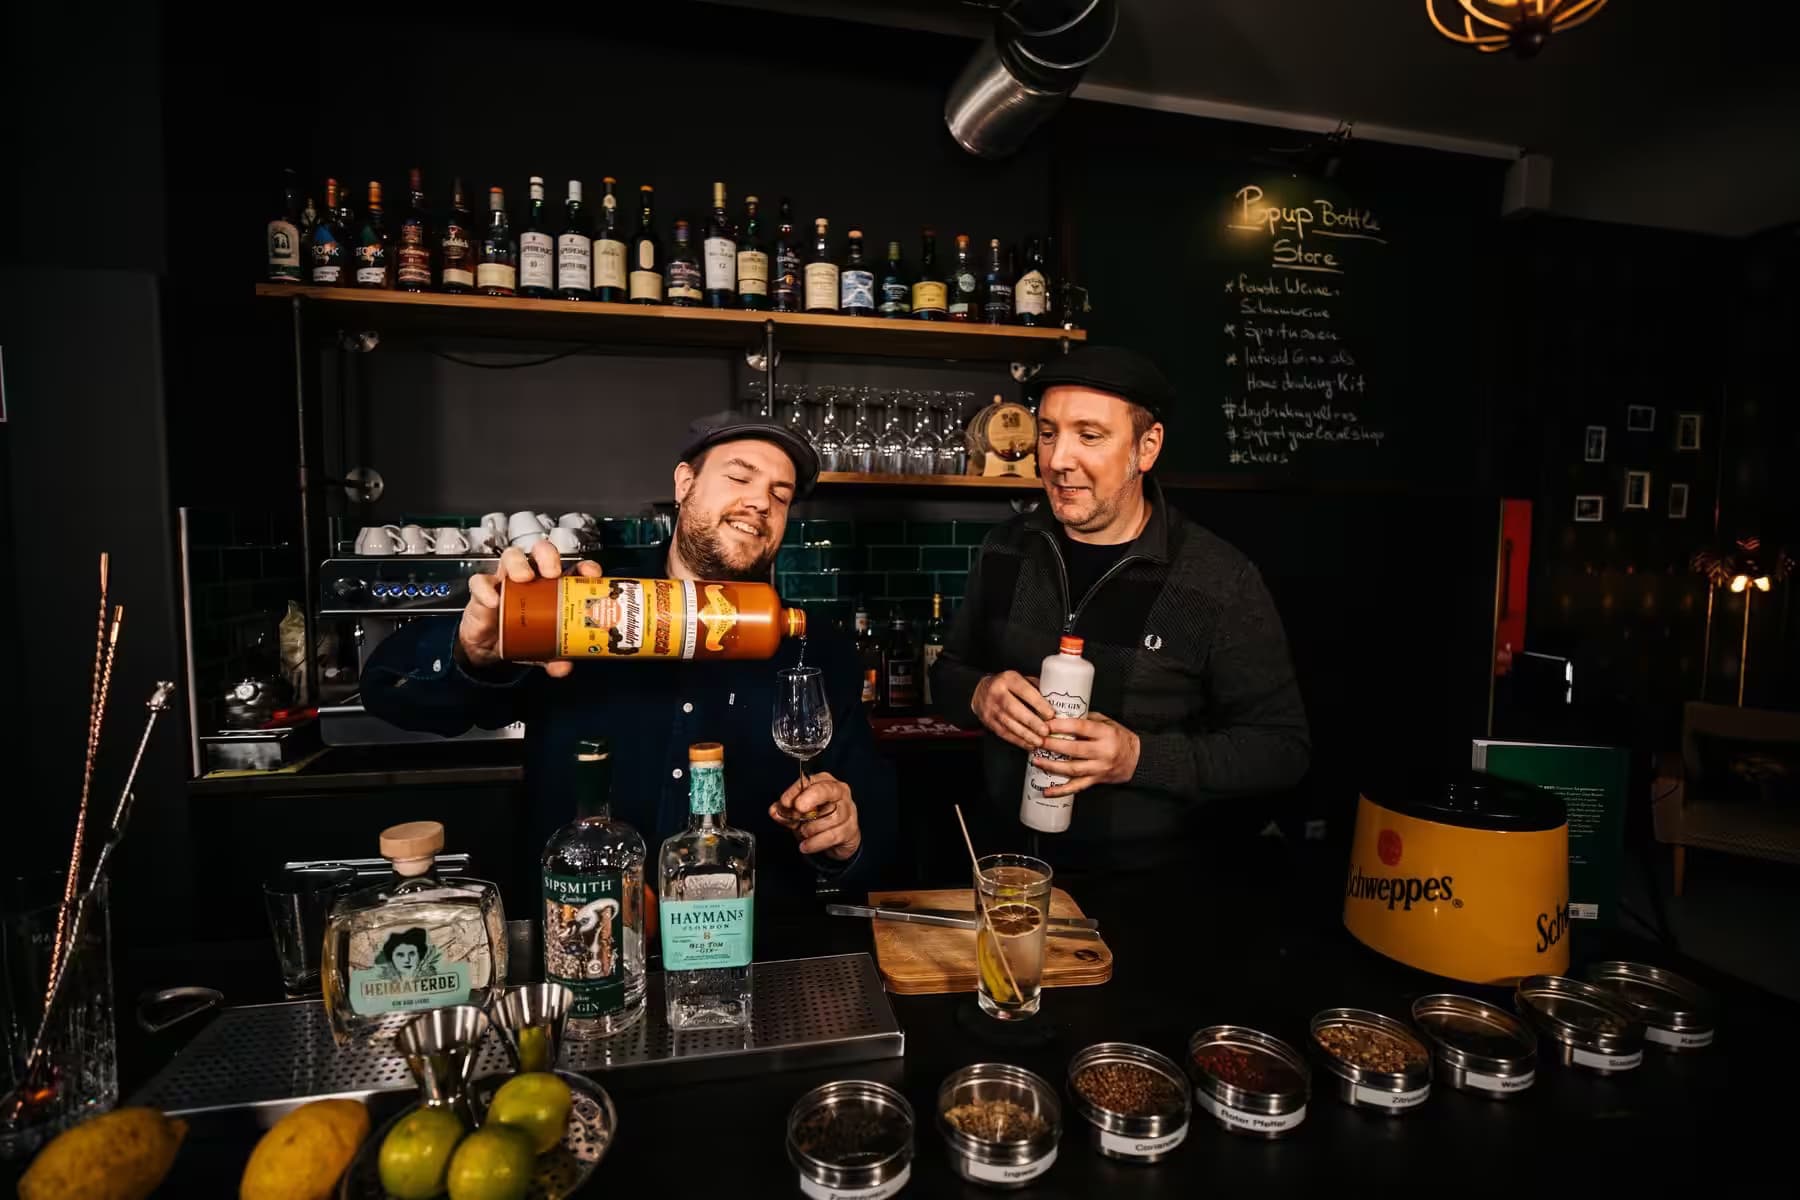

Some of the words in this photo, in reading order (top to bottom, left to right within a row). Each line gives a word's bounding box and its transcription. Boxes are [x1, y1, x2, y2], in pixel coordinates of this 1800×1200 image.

[1235, 185, 1314, 240] Popup
[1313, 199, 1381, 231] Bottle
[1272, 238, 1339, 266] Store
[1337, 371, 1366, 393] Kit
[1069, 702, 1082, 711] GIN
[544, 876, 612, 894] SIPSMITH
[365, 975, 456, 997] HEIMATERDE
[576, 1001, 600, 1014] GIN
